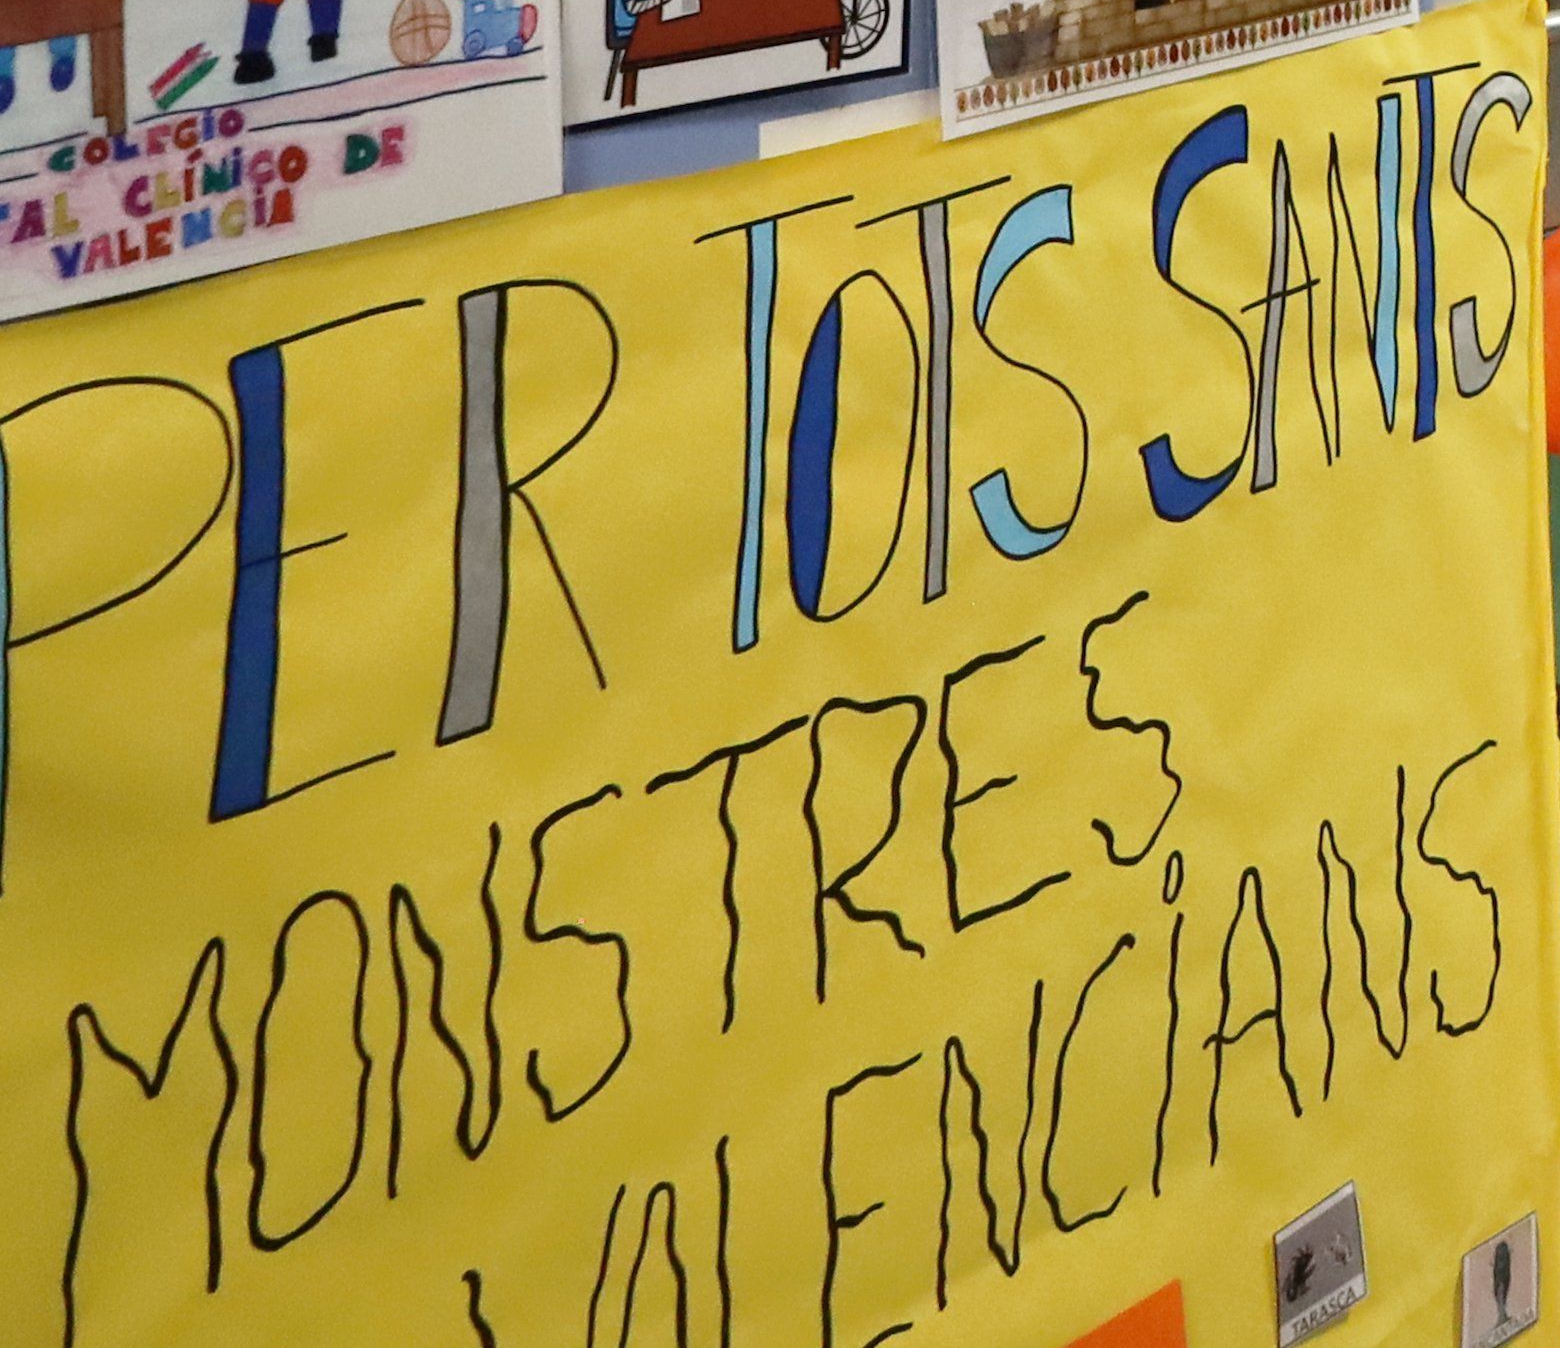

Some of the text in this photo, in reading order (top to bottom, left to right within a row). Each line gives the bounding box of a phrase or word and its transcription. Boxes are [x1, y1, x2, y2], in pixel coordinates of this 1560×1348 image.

[0, 192, 80, 245] AL
[343, 124, 406, 176] DE
[0, 61, 1534, 895] PER TOTS SANTS
[63, 591, 1183, 1348] MONSTRES
[1291, 1286, 1357, 1339] TARASCA
